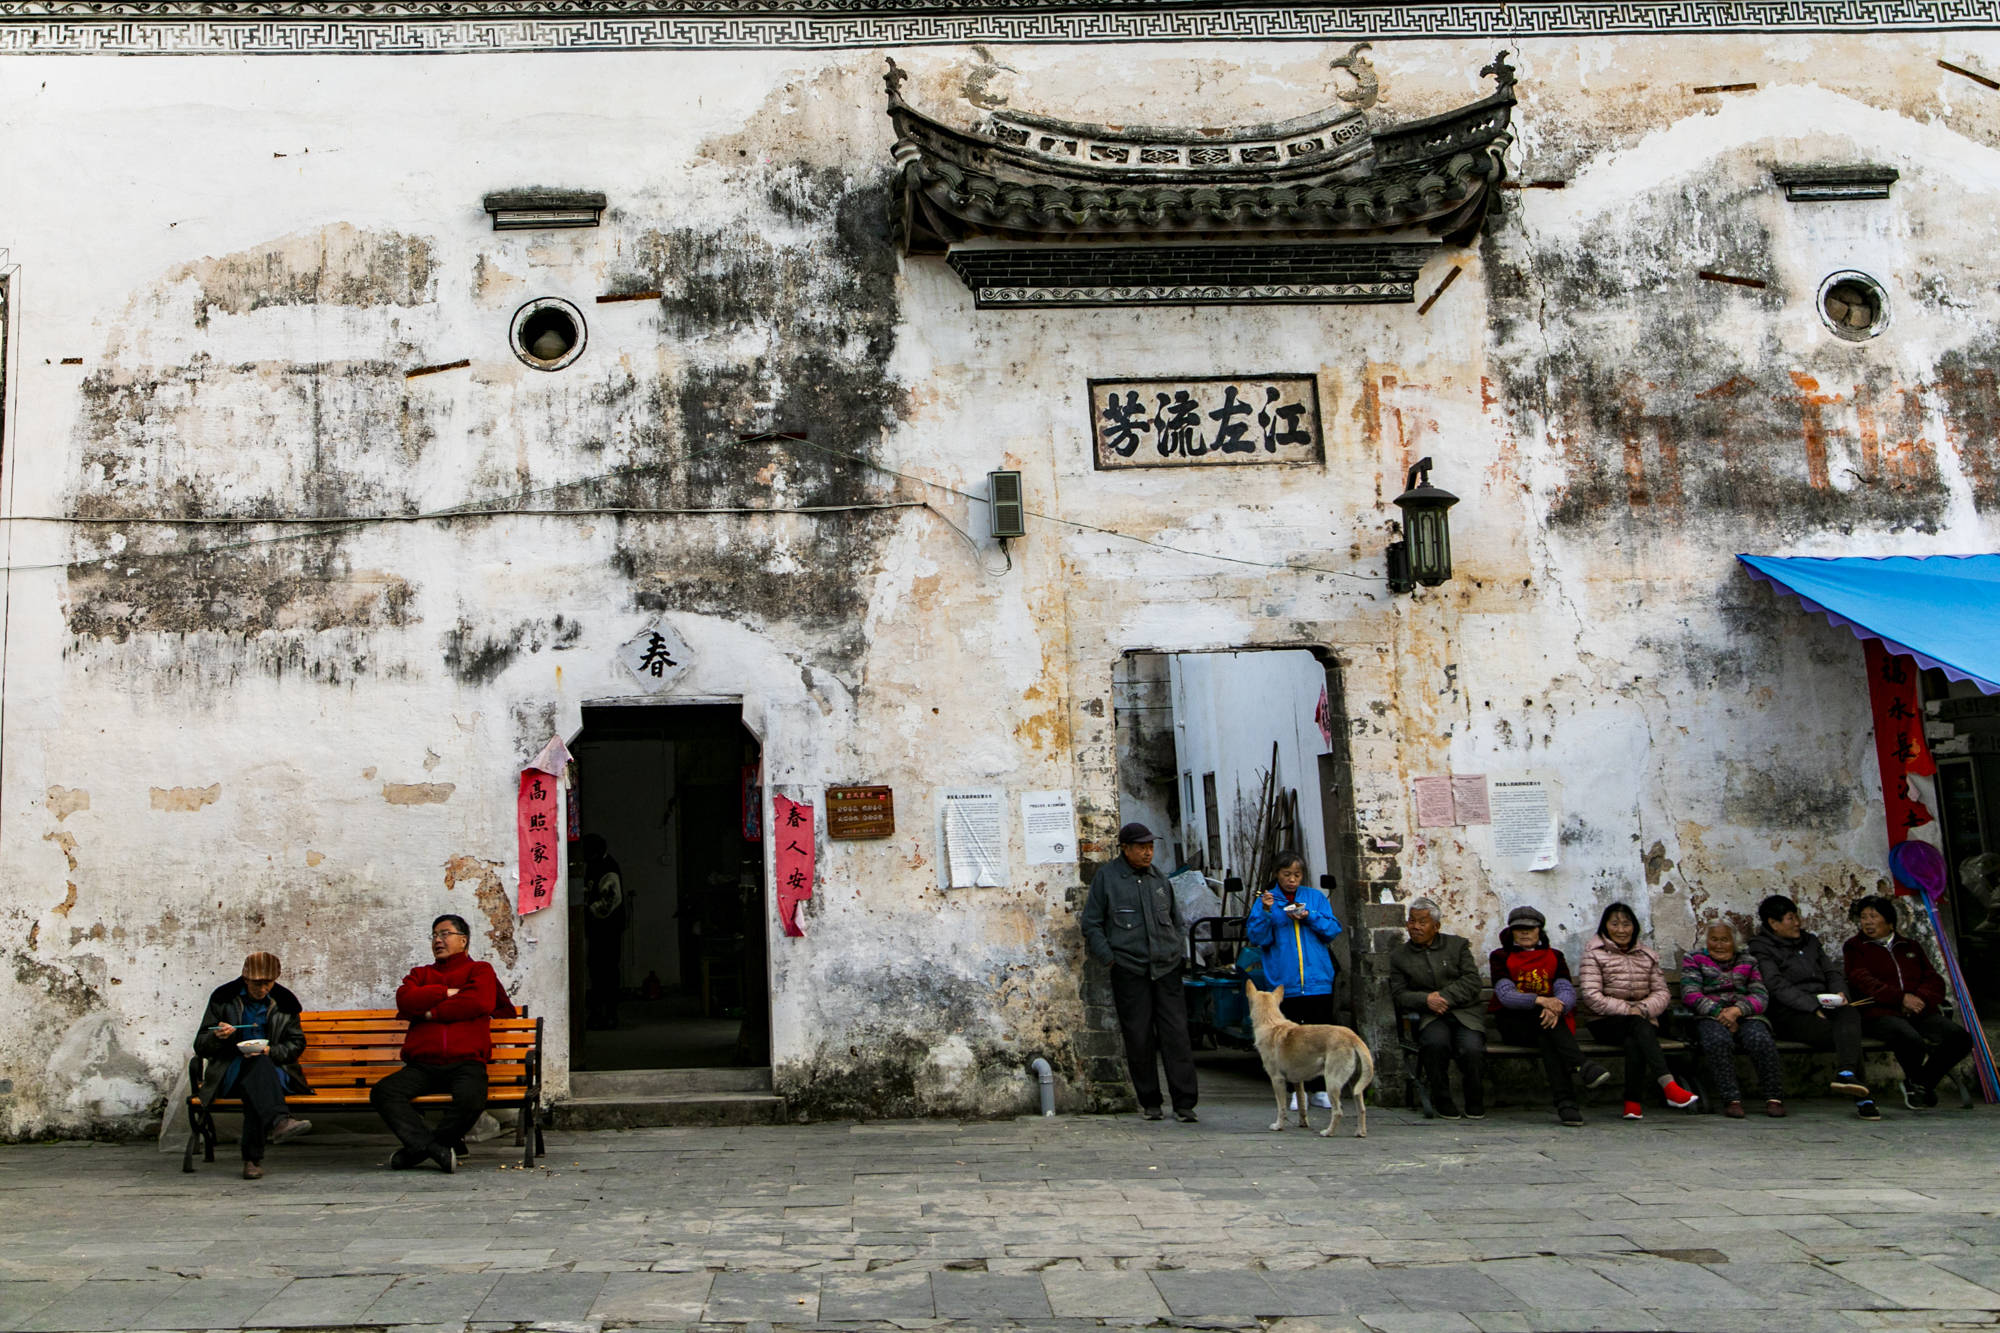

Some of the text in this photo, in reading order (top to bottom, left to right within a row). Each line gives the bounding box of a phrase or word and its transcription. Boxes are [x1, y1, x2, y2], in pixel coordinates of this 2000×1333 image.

[637, 631, 678, 678] 春
[528, 779, 549, 911] 高照家富
